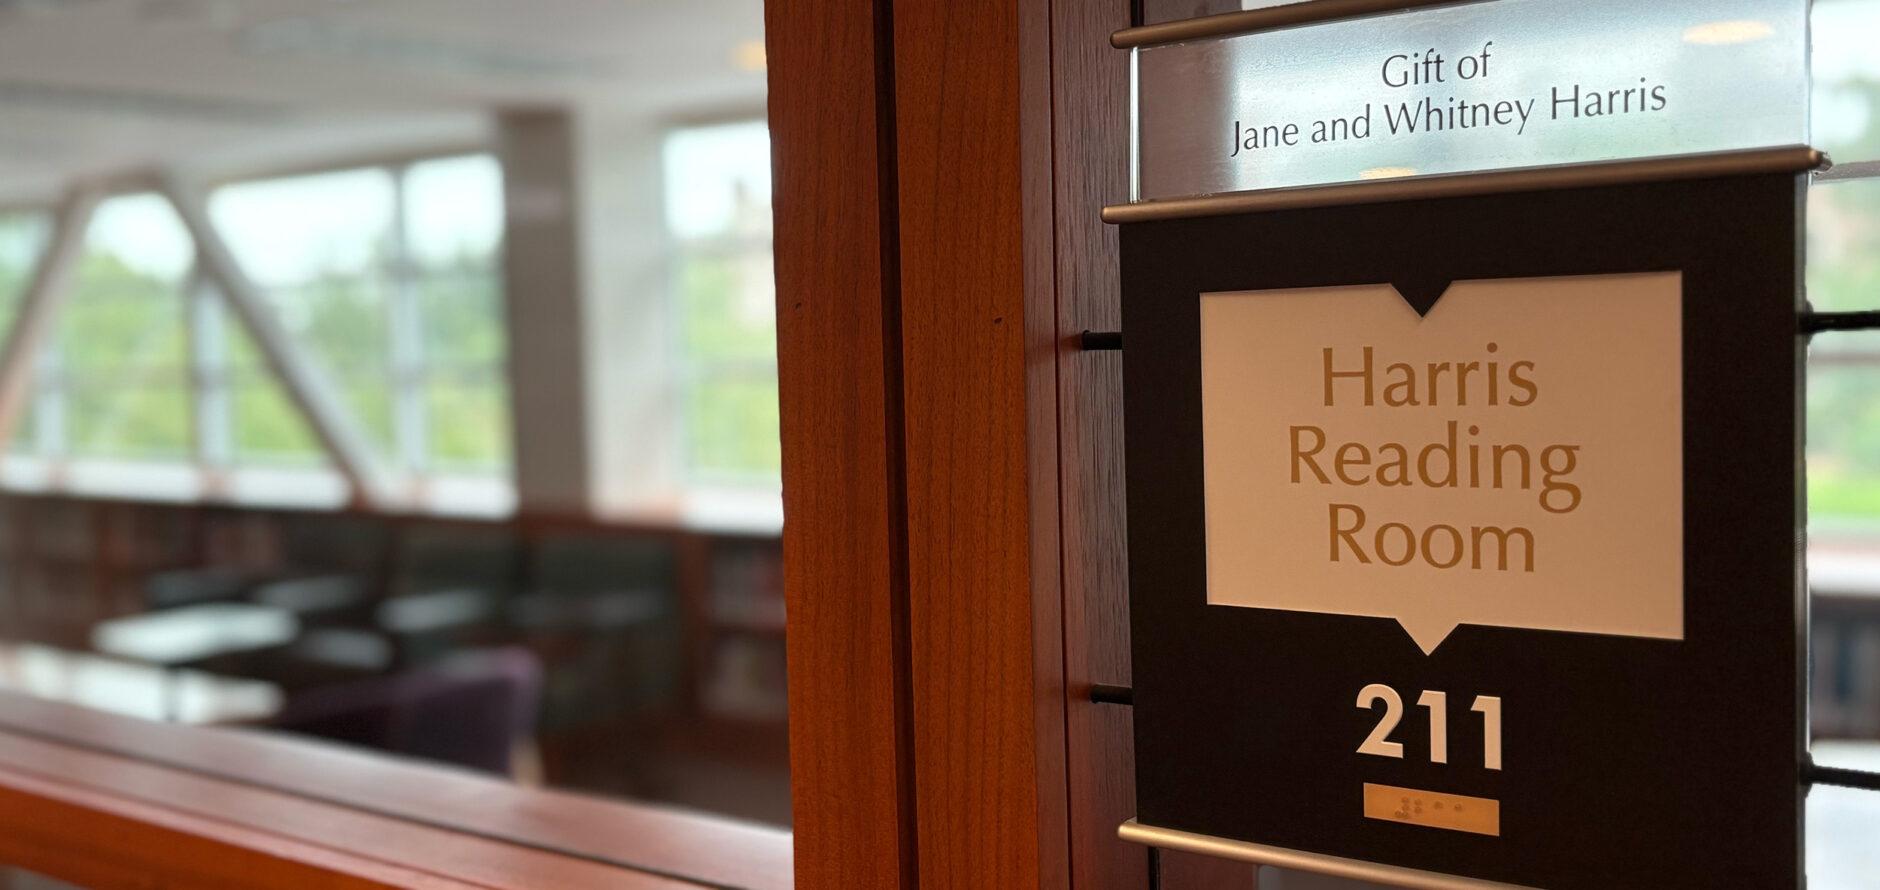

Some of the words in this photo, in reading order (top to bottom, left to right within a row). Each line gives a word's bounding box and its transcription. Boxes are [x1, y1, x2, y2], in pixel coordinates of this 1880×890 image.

[1381, 48, 1446, 88] Gift
[1457, 41, 1494, 80] of
[1231, 118, 1300, 157] Jane
[1310, 104, 1371, 143] and
[1384, 96, 1535, 135] Whitney
[1550, 77, 1668, 122] Harris
[1322, 342, 1539, 407] Harris
[1289, 420, 1582, 514] Reading
[1328, 503, 1535, 572] Room
[1355, 683, 1502, 771] 211
